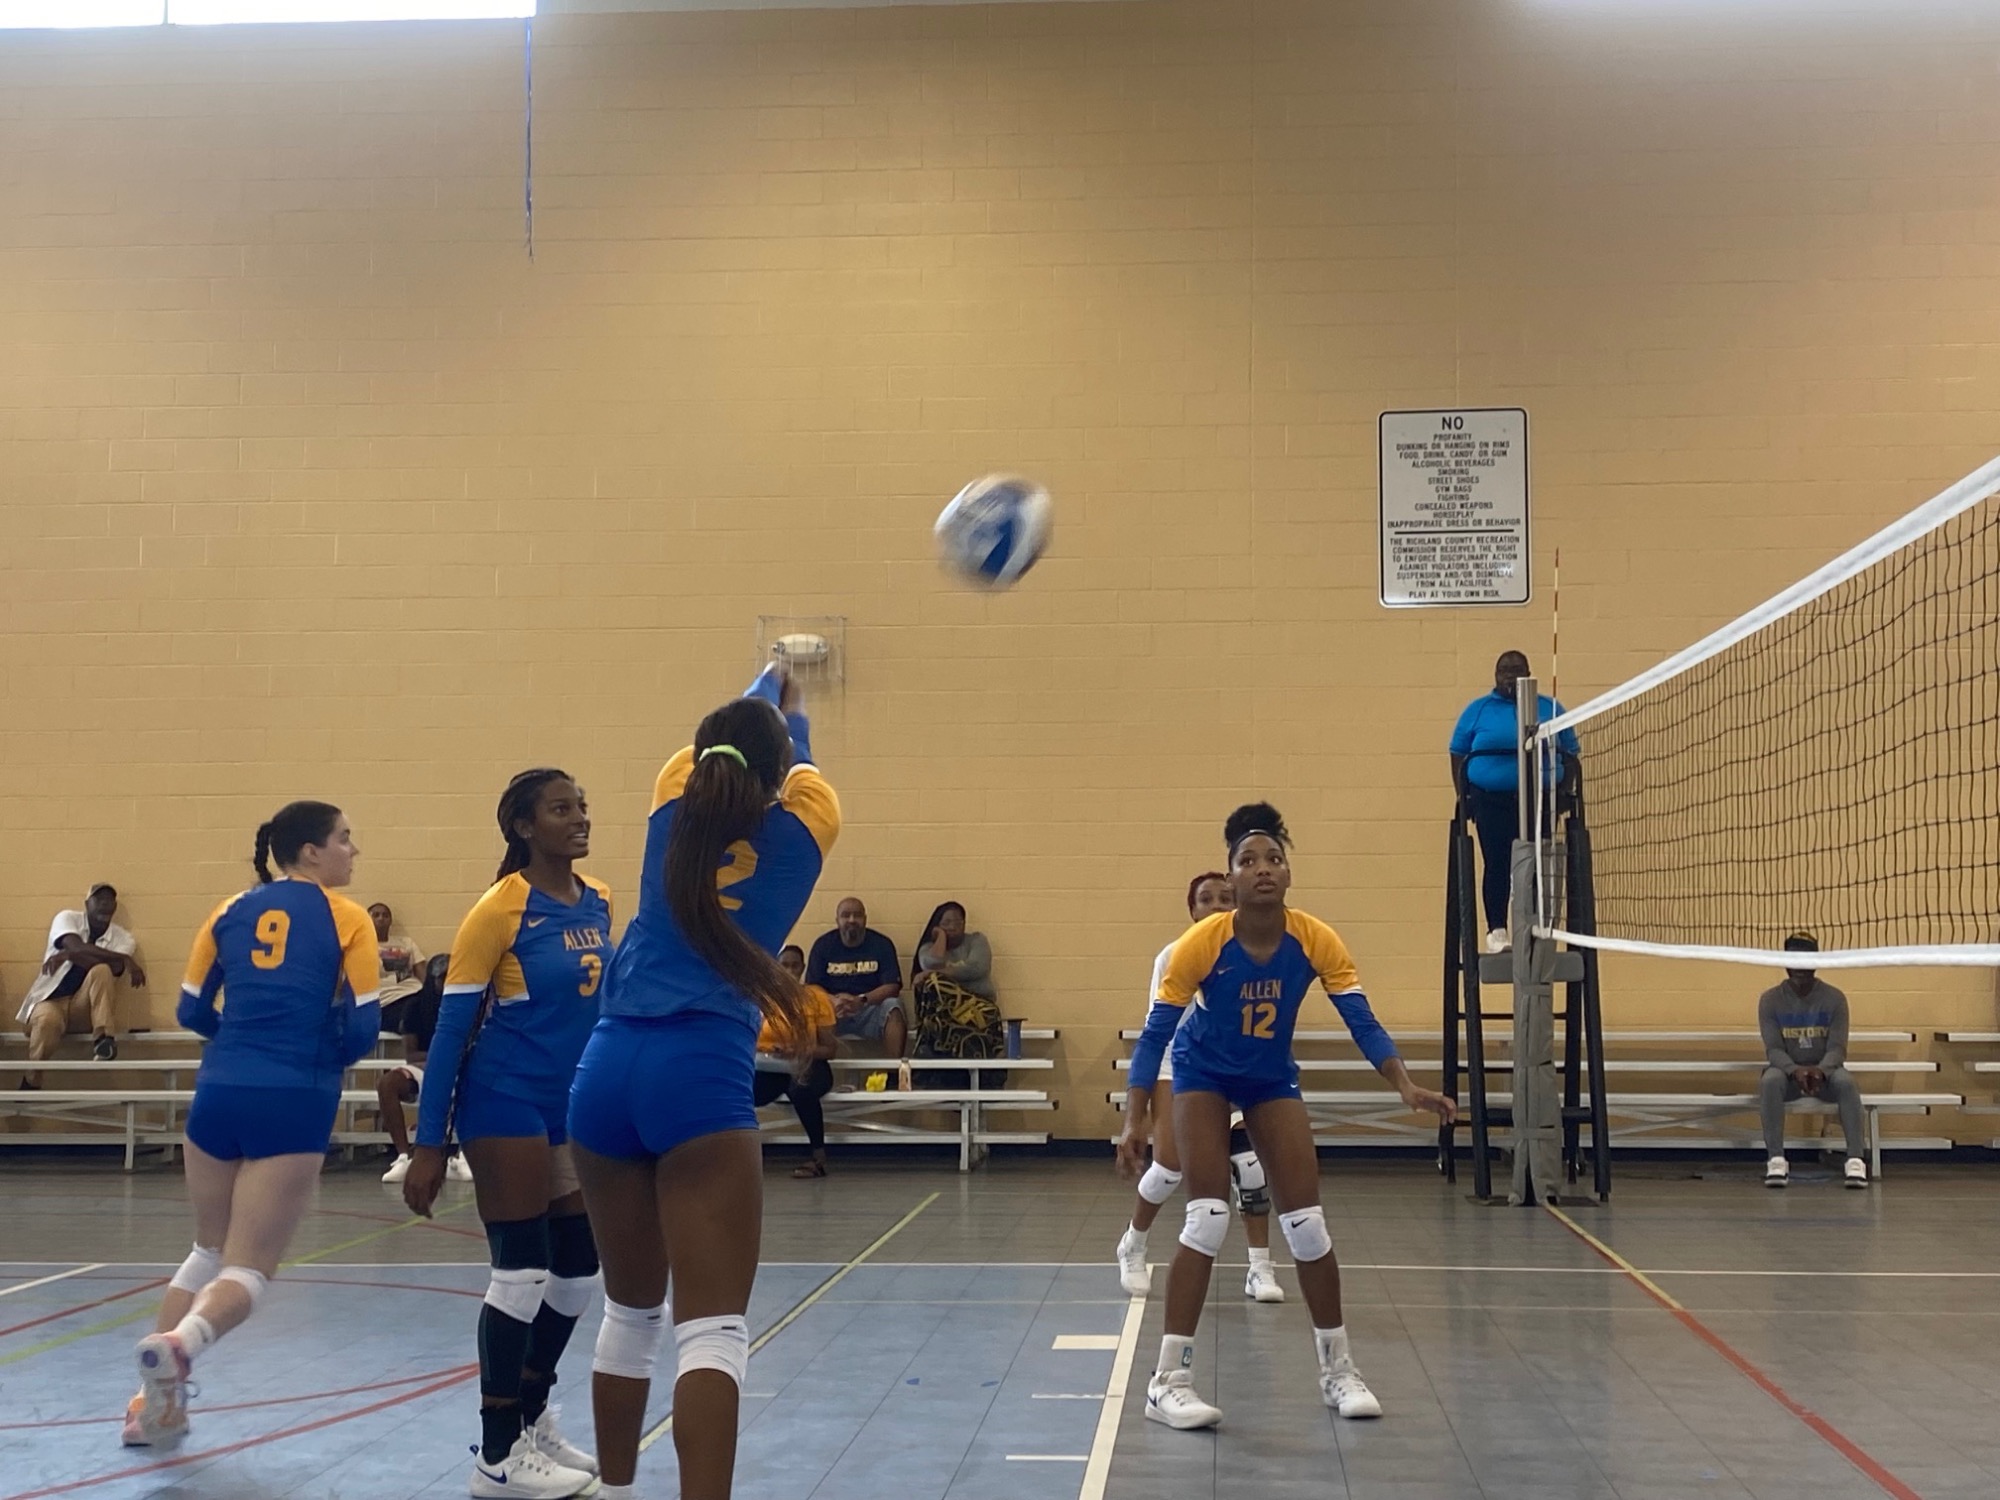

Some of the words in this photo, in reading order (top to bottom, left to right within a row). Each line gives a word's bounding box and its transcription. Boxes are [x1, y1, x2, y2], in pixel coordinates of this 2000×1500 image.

[1442, 416, 1464, 430] NO
[1455, 458, 1495, 467] BEVERAGES
[1415, 502, 1456, 511] CONCEALED
[1460, 501, 1493, 509] WEAPONS
[1433, 511, 1474, 519] HORSEPLAY
[1388, 520, 1442, 528] INAPPROPRIATE
[1476, 536, 1520, 544] RECREATION
[1393, 546, 1436, 554] COMMISSION
[1397, 572, 1441, 580] SUSPENSION
[1416, 579, 1435, 588] FROM
[716, 839, 759, 911] 2
[251, 909, 291, 970] 9
[563, 927, 605, 951] ALLEN
[579, 953, 602, 997] 3
[1240, 979, 1282, 1000] ALLEN
[1241, 1002, 1277, 1039] 12
